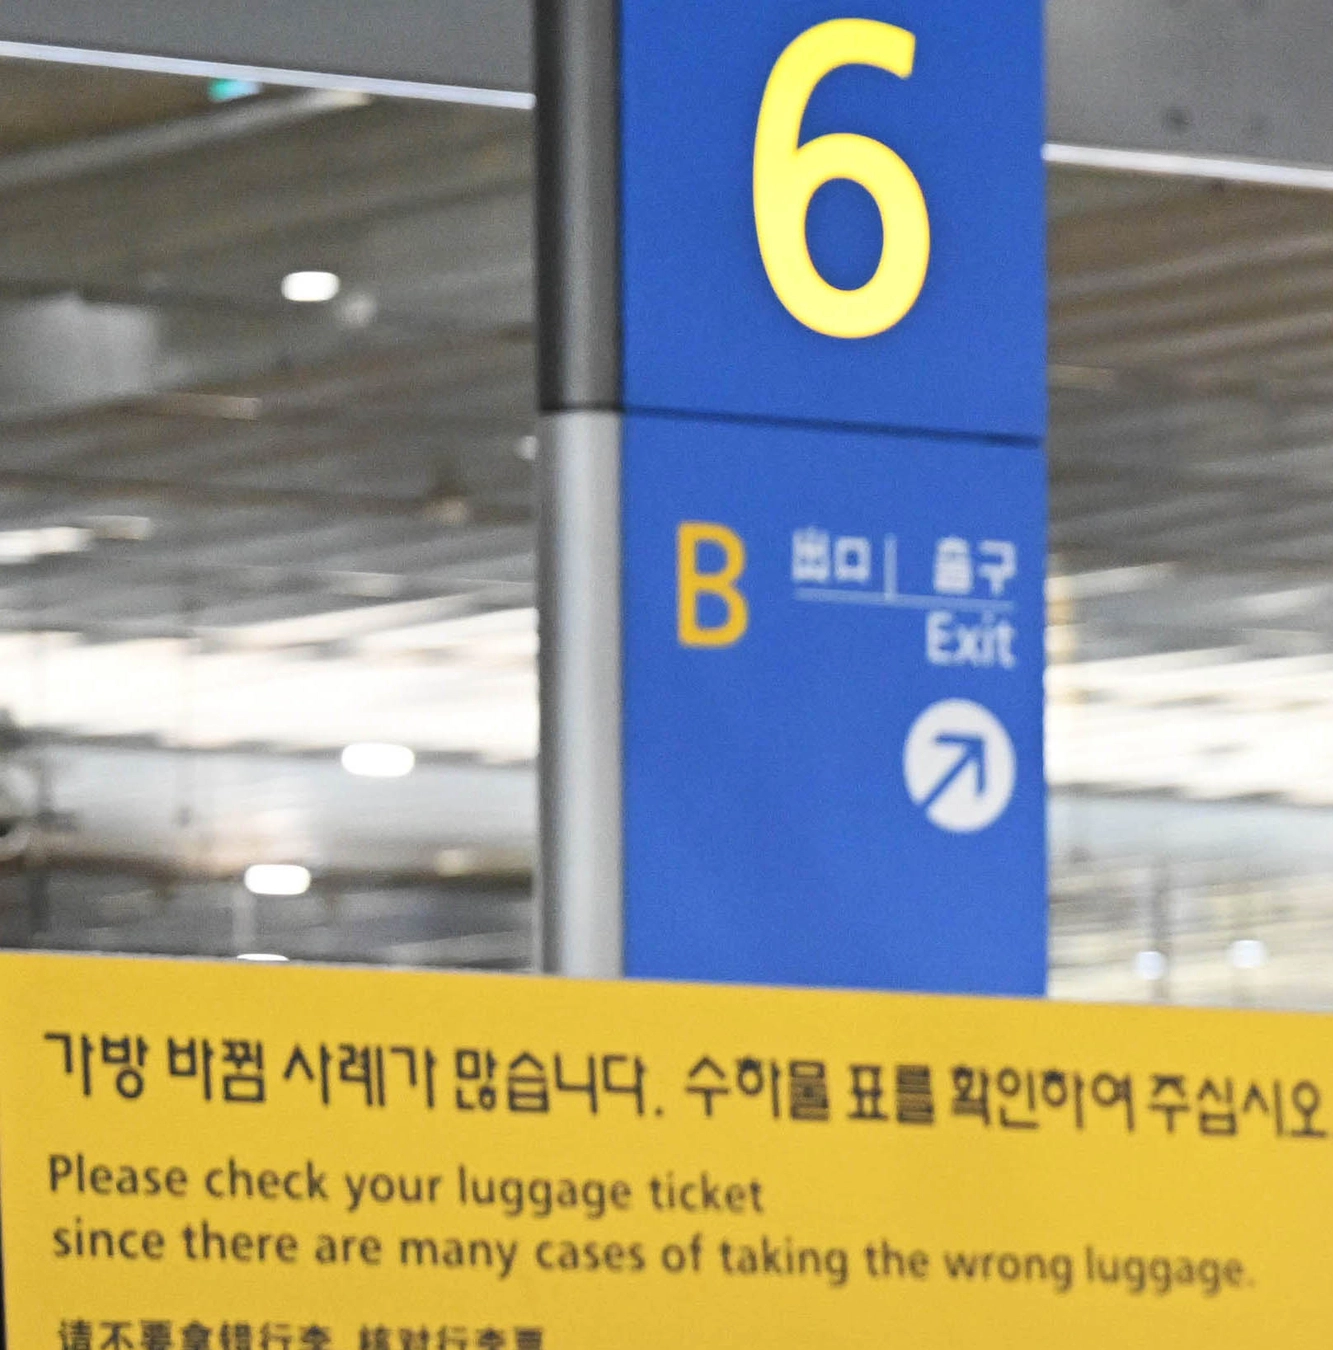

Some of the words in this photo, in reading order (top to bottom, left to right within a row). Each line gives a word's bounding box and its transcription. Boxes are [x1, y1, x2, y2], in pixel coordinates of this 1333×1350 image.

[752, 17, 931, 340] 6
[675, 520, 749, 648] B
[792, 526, 871, 584] 出口
[933, 534, 1017, 597] 출구
[926, 609, 1017, 669] Exit
[43, 1031, 150, 1101] 가방
[166, 1035, 267, 1105] 바뀜
[282, 1041, 438, 1110] 사례가
[453, 1046, 665, 1118] 많습니다.
[684, 1054, 831, 1123] 수하물
[846, 1062, 936, 1127] 표를
[950, 1063, 1136, 1133] 확인하여
[48, 1152, 188, 1198] Please
[204, 1157, 328, 1201] check
[344, 1173, 442, 1213] your
[457, 1164, 632, 1221] luggage
[648, 1172, 764, 1213] ticket
[52, 1216, 166, 1261] since
[181, 1219, 299, 1264] there
[314, 1233, 383, 1266] are
[399, 1237, 519, 1280] many
[535, 1239, 646, 1273] cases
[661, 1231, 703, 1273] of
[718, 1235, 849, 1288] taking
[863, 1239, 930, 1280] the
[943, 1251, 1074, 1294] wrong
[1085, 1245, 1257, 1297] luggage.
